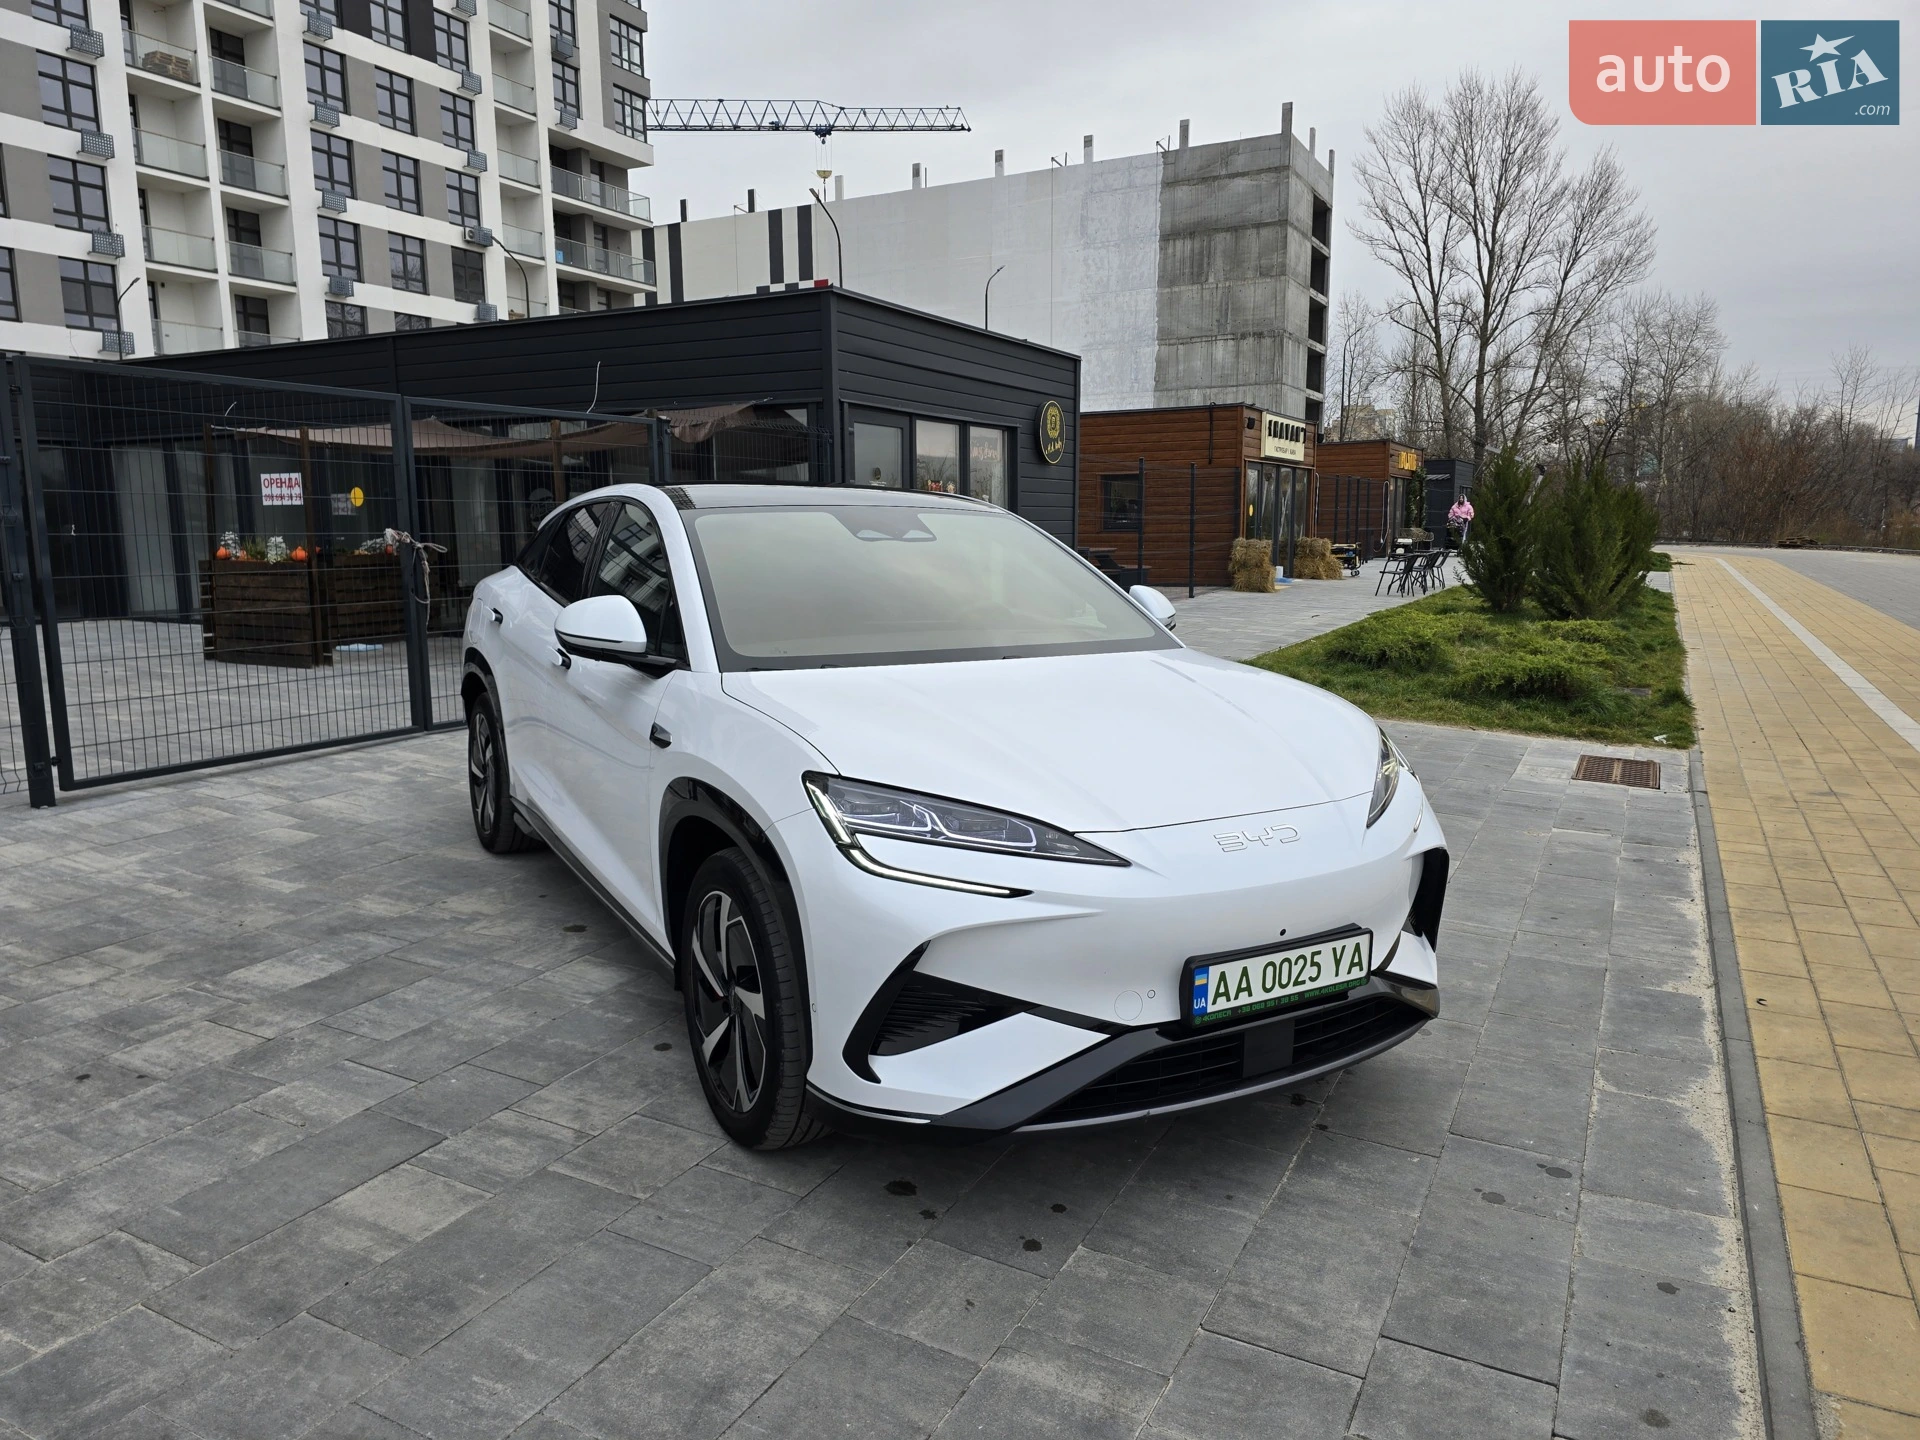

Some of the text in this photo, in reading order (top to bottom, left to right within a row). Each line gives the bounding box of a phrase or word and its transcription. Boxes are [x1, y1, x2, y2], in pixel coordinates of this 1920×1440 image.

[263, 477, 301, 490] ОРЕНДА
[1213, 824, 1301, 853] BYD
[1211, 942, 1364, 1006] AA 0025 YA
[1193, 998, 1207, 1009] UA
